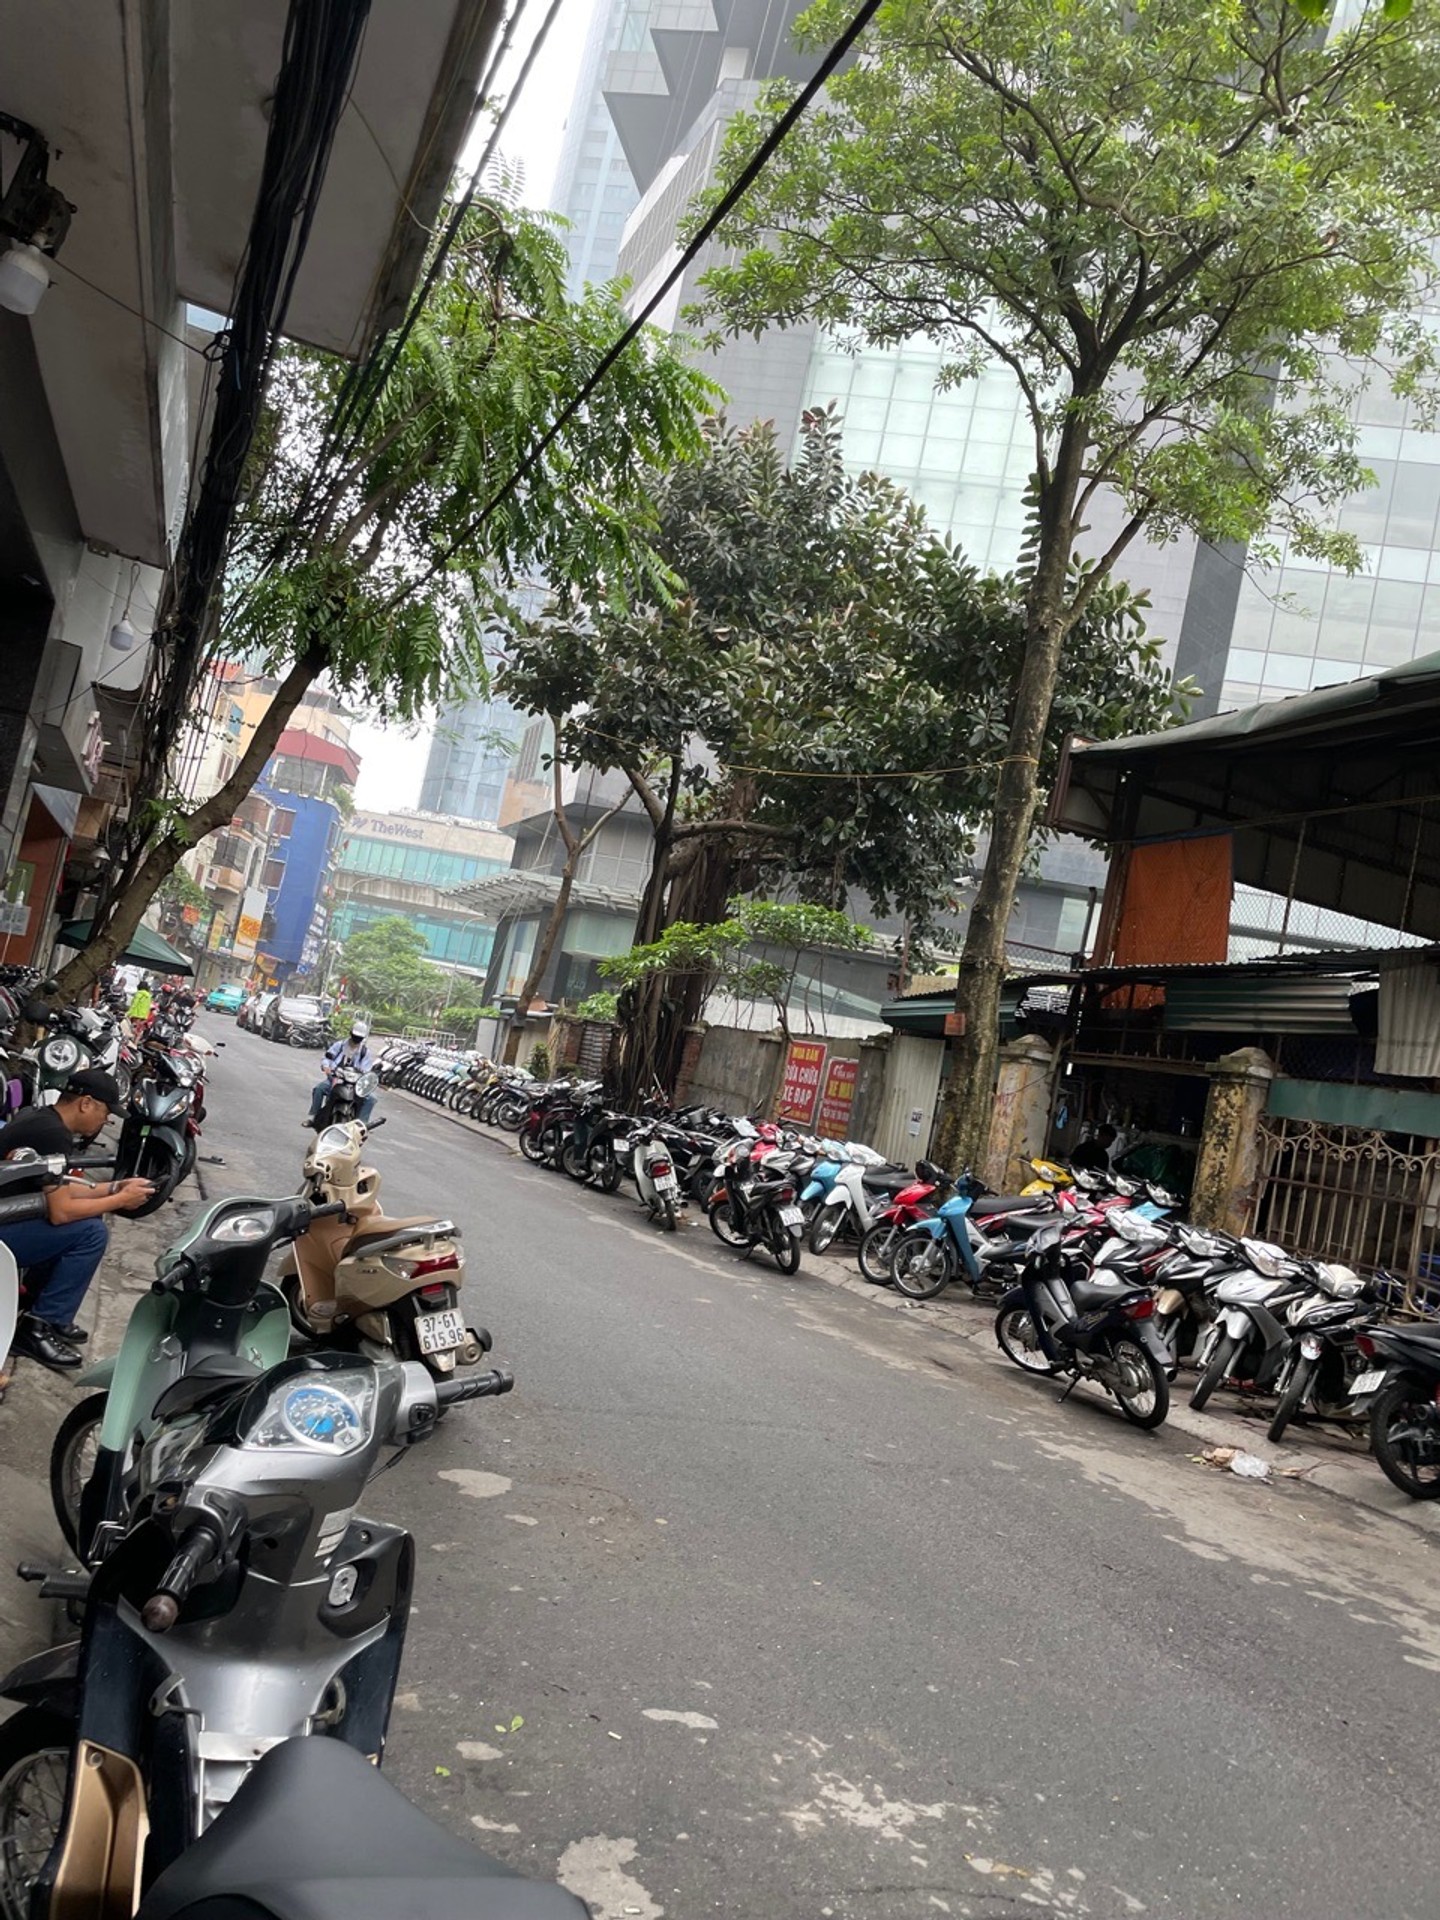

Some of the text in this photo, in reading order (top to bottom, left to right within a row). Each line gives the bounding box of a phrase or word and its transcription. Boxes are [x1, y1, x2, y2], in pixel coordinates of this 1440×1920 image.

[371, 819, 424, 839] TheWest
[782, 1085, 793, 1102] XE
[423, 1313, 456, 1333] 37-G1
[423, 1328, 464, 1350] 615.96
